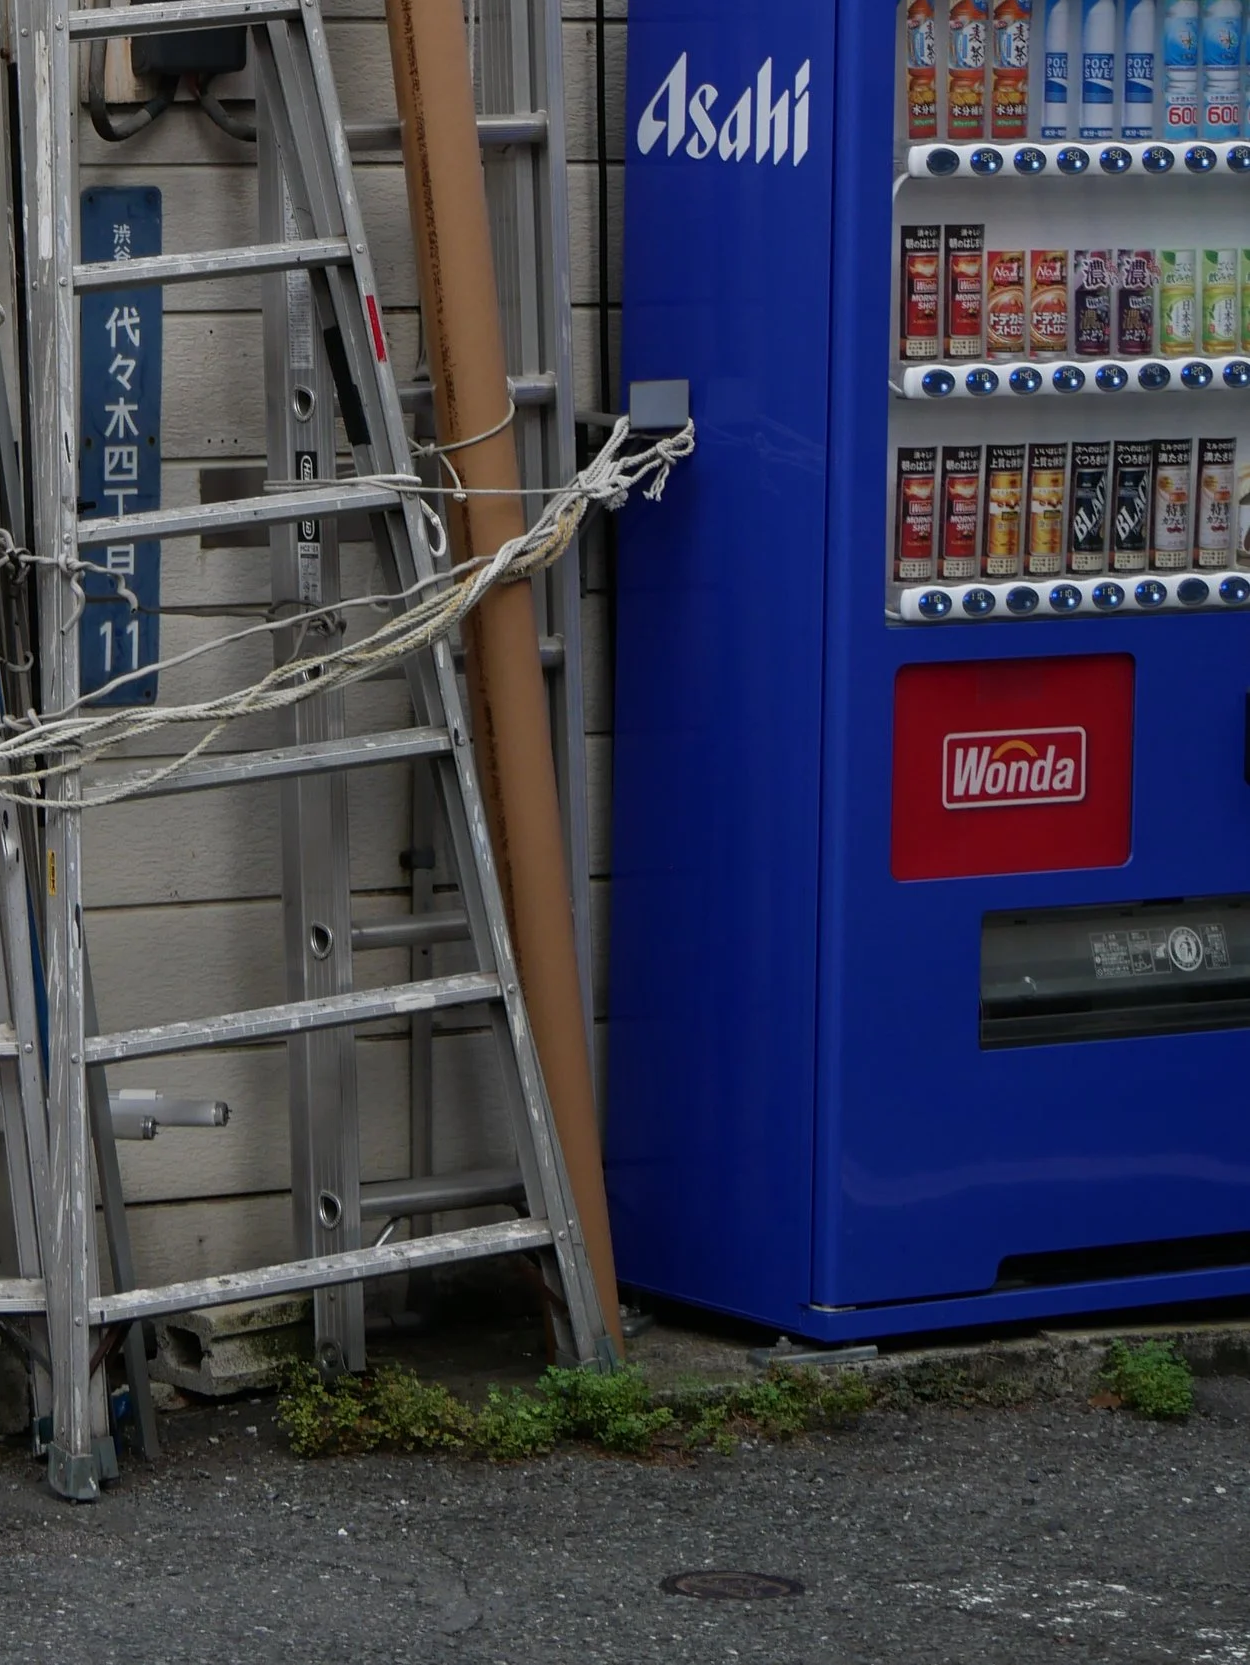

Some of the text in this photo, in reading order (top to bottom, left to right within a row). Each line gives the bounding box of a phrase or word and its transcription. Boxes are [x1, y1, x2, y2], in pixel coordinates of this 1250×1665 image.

[636, 49, 811, 168] Asahi
[113, 224, 131, 261] 渋谷
[1182, 299, 1191, 336] 日本茶
[1224, 298, 1233, 336] 日本茶
[103, 306, 141, 576] 代々木四丁目
[99, 619, 139, 672] 11
[952, 743, 1075, 797] Wonda
